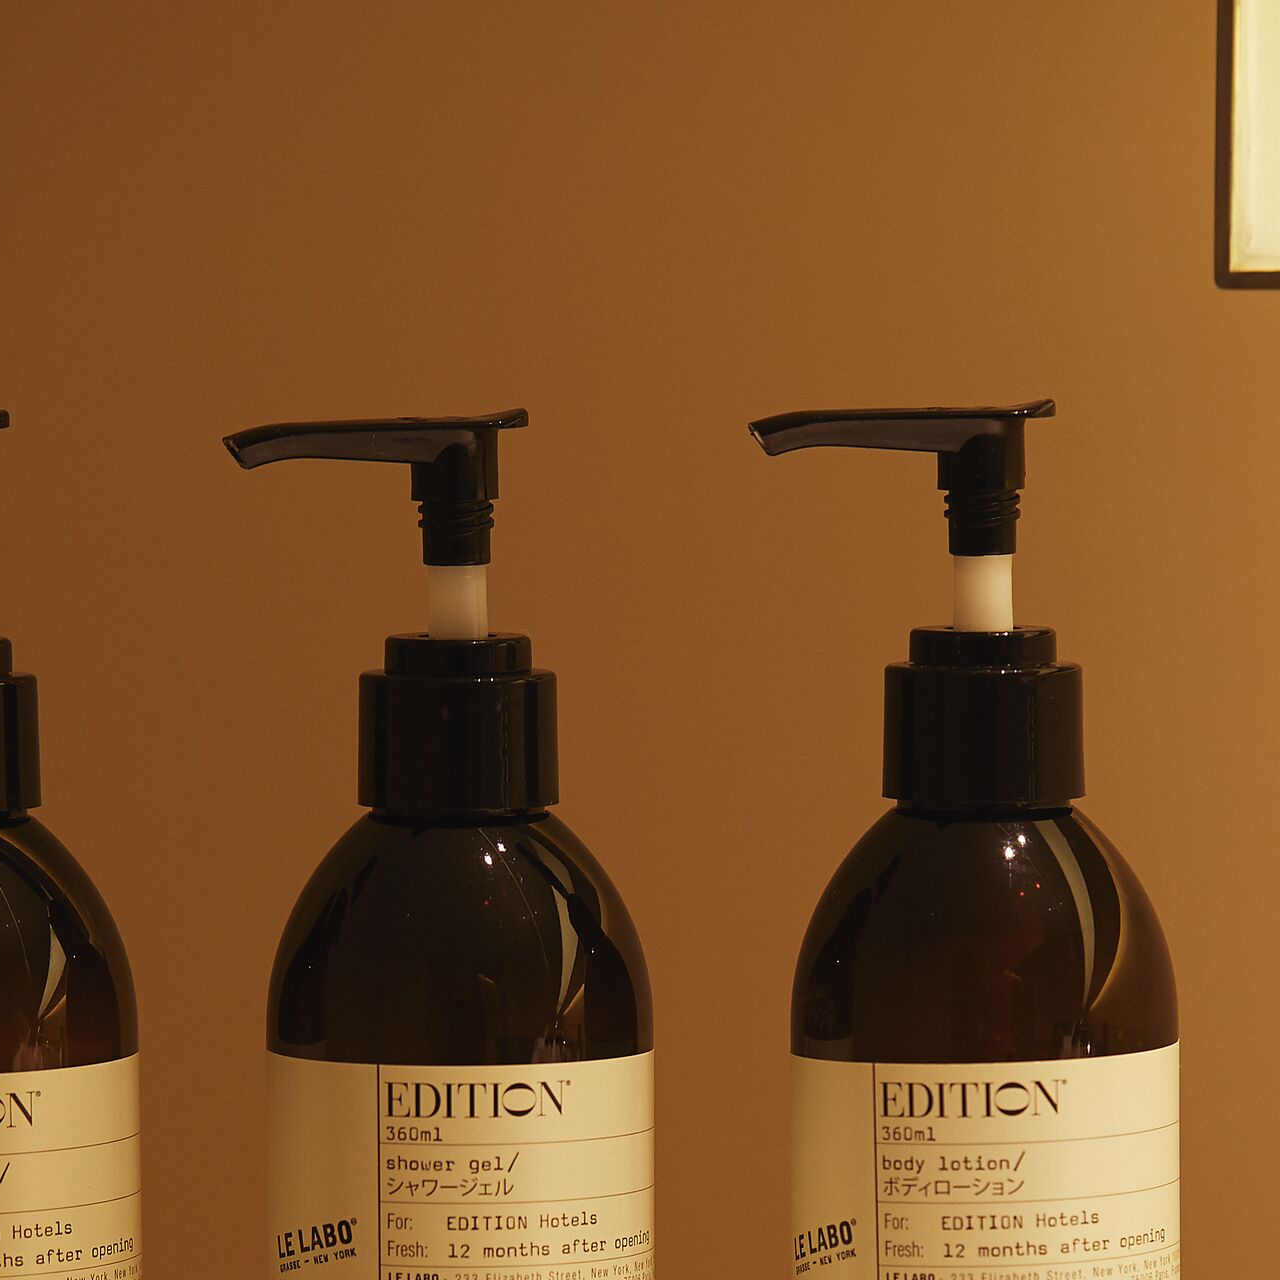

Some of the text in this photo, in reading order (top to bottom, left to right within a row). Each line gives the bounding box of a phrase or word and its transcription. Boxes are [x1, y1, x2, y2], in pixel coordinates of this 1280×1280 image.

[386, 1126, 443, 1142] 360ml
[882, 1126, 936, 1142] 360ml
[386, 1155, 455, 1172] shower
[882, 1155, 925, 1174] body
[387, 1177, 514, 1197] シャワージェル
[883, 1176, 1025, 1197] ボディローション
[12, 1221, 72, 1239] Hotels
[387, 1211, 597, 1231] For: EDITION Hotels
[884, 1210, 1099, 1231] For: EDITION Hotels
[36, 1248, 83, 1265] after
[92, 1237, 133, 1261] opening
[277, 1232, 295, 1259] LE
[387, 1230, 649, 1259] Fresh: 12 months after opening
[794, 1234, 806, 1261] LE
[884, 1228, 1165, 1258] Fresh: 12 months after opening
[313, 1253, 329, 1265] NEW
[333, 1247, 357, 1260] YORK
[819, 1254, 832, 1266] NEW
[835, 1248, 857, 1261] YORK
